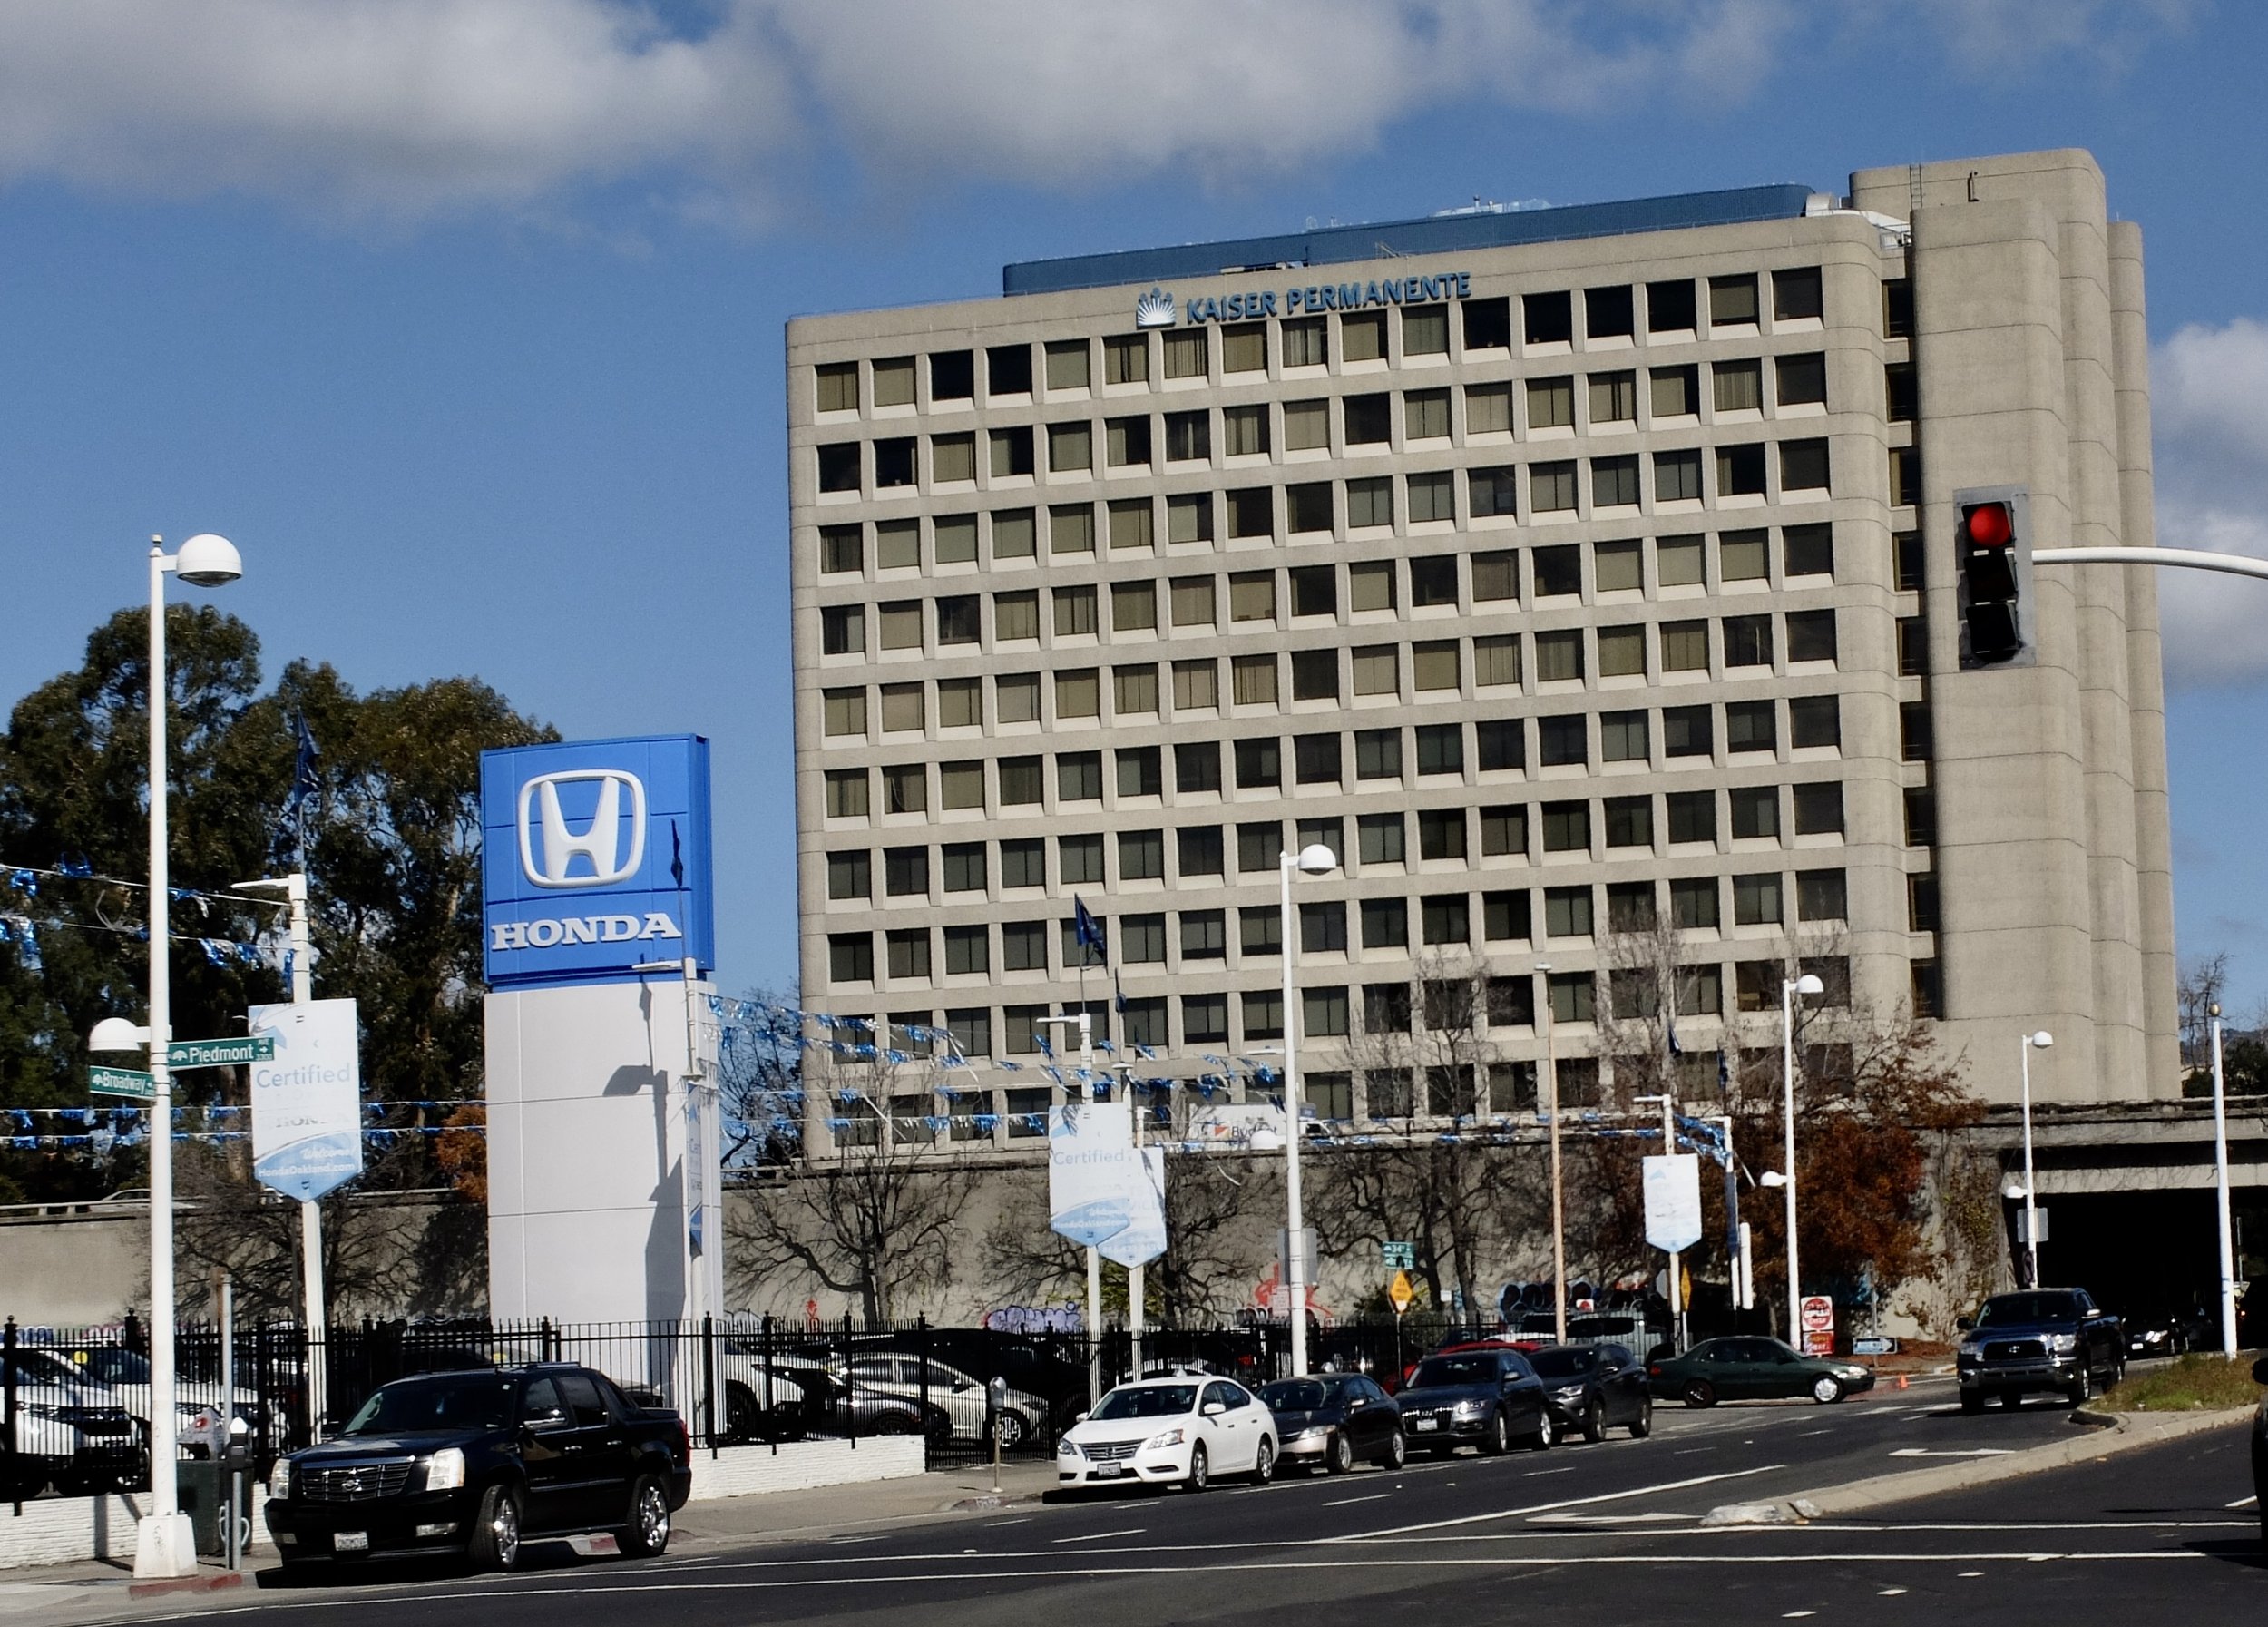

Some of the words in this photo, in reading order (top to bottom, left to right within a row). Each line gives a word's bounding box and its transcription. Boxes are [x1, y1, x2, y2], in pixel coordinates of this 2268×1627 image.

[1187, 291, 1277, 325] KAISER
[1286, 271, 1471, 315] PERMANENTE
[491, 912, 682, 951] HONDA
[188, 1044, 254, 1063] Piedmont
[102, 1071, 146, 1095] Broadway
[256, 1063, 350, 1089] Certified
[1053, 1148, 1125, 1166] Certified
[259, 1162, 355, 1178] HondaOakland.com
